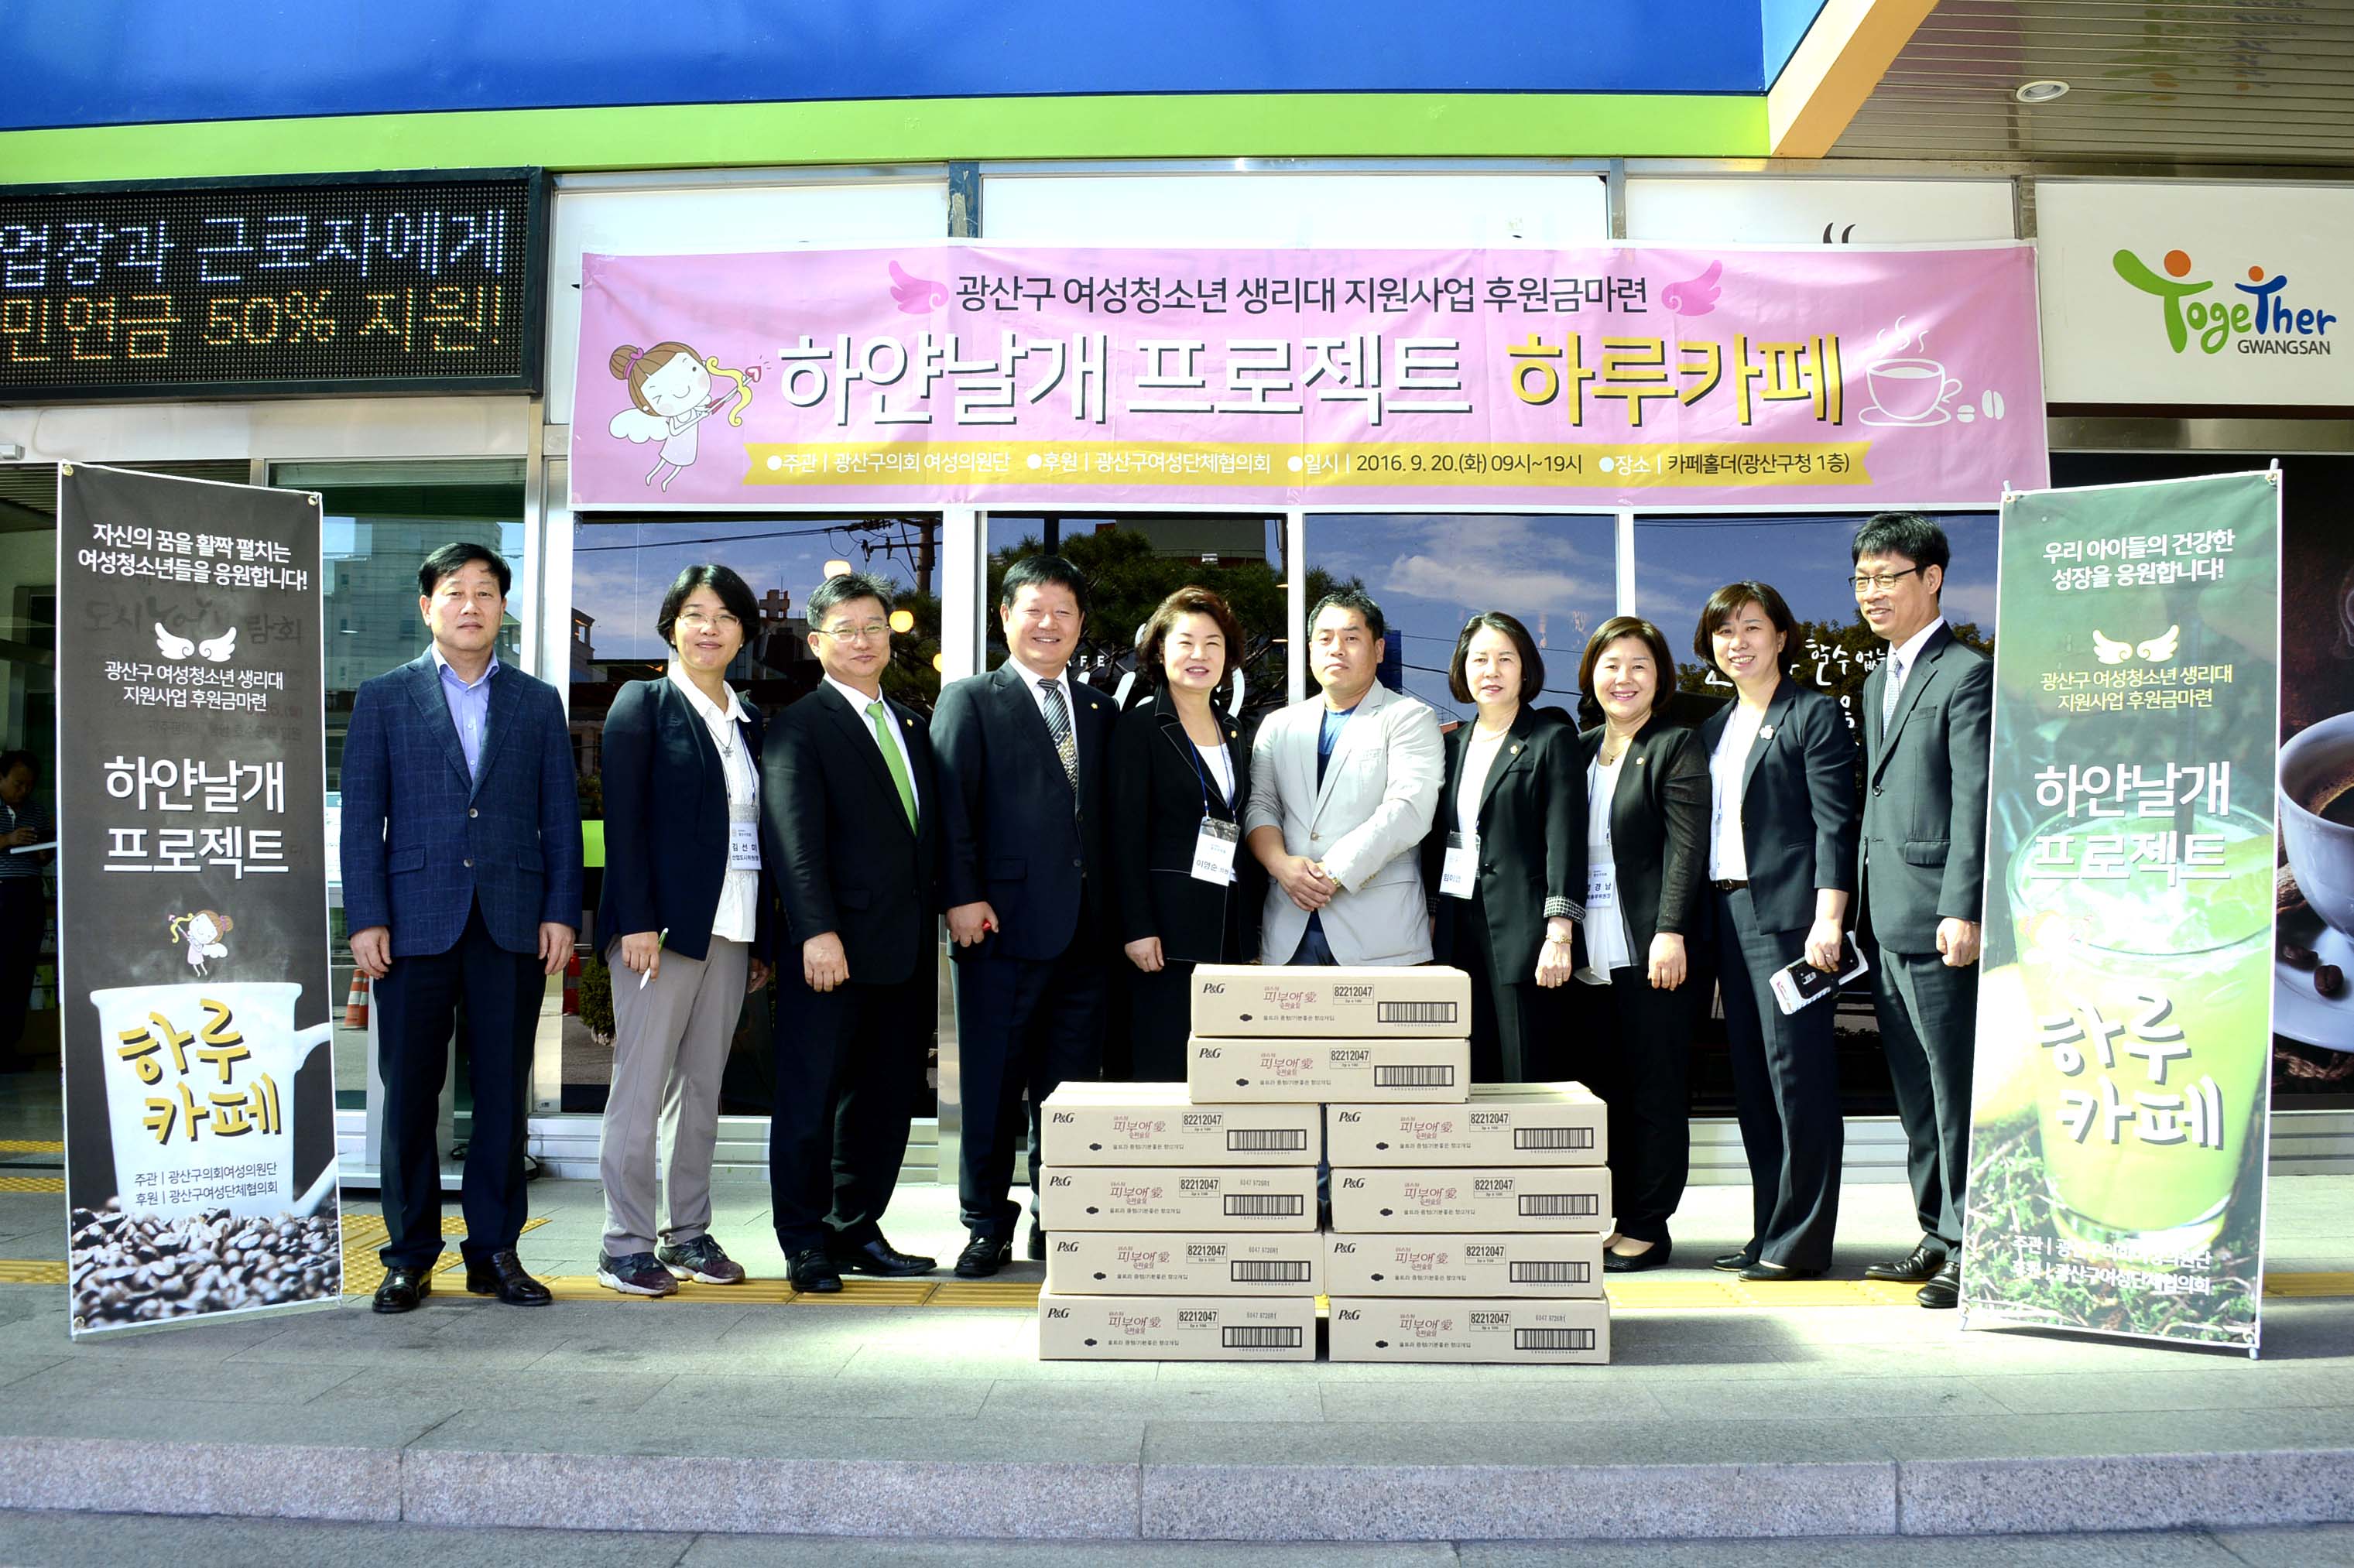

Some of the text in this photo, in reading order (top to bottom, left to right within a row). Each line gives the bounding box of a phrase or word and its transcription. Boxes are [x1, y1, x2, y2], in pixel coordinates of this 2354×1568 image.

[0, 210, 505, 288] 업장과 근로자에게
[955, 275, 1647, 315] 광산구 여성청소년 생리대 지원사업 후원금마련
[203, 289, 336, 345] 50%
[358, 284, 503, 353] 지원!
[2237, 340, 2331, 355] GWANGSAN
[778, 330, 1844, 427] 하얀날개 프로젝트 하루카페
[834, 450, 921, 474] 광산구의회
[924, 450, 1011, 474] 여성의원단
[1095, 450, 1271, 474] 광산구여성단체협의회
[1491, 453, 1582, 474] 09시~19시
[1667, 453, 1813, 476] 카페홀더(광산구청
[1818, 453, 1850, 474] 1층)
[93, 523, 292, 564] 자신의 꿈을 활짝 펼치는
[2042, 528, 2236, 565] 우리 아이들의 건강한
[77, 549, 309, 591] 여성청소년들을 응원합니다!
[2051, 557, 2224, 592] 성장을 응원합니다!
[105, 661, 283, 690] 광산구 여성청소년 생리대
[2040, 664, 2232, 691] 광산구 여성청소년 생리대
[123, 686, 267, 713] 지원사업 후원금마련
[2058, 687, 2212, 712] 지원사업 후원금마련
[103, 755, 285, 813] 하얀날개
[2034, 761, 2230, 818] 하얀날개
[103, 826, 289, 880] 프로젝트
[2031, 830, 2232, 887] 프로젝트
[1202, 982, 1225, 994] P&G
[1334, 986, 1372, 997] 82212047
[117, 997, 252, 1085] 하루
[2036, 991, 2192, 1085] 하루
[1199, 1047, 1222, 1059] P&G
[1331, 1050, 1369, 1061] 82212047
[142, 1072, 283, 1146] 카페
[1052, 1111, 1074, 1123] P&G
[1184, 1114, 1222, 1125] 82212047
[1339, 1111, 1361, 1122] P&G
[1471, 1113, 1509, 1124] 82212047
[2056, 1074, 2224, 1151] 카페
[134, 1162, 277, 1187] 주관 광산구의회여성의원단
[1049, 1176, 1071, 1187] P&G
[1180, 1179, 1218, 1190] 82212047
[1343, 1177, 1365, 1189] P&G
[1475, 1179, 1513, 1190] 82212047
[135, 1181, 279, 1206] 후원 광산구여성단체협의회
[1056, 1241, 1078, 1251] P&G
[1187, 1245, 1226, 1255] 82212047
[1334, 1241, 1356, 1253] P&G
[1466, 1246, 1504, 1256] 82212047
[1047, 1307, 1070, 1318] P&G
[1179, 1311, 1217, 1321] 82212047
[1338, 1309, 1360, 1320] P&G
[1471, 1313, 1509, 1323] 82212047
